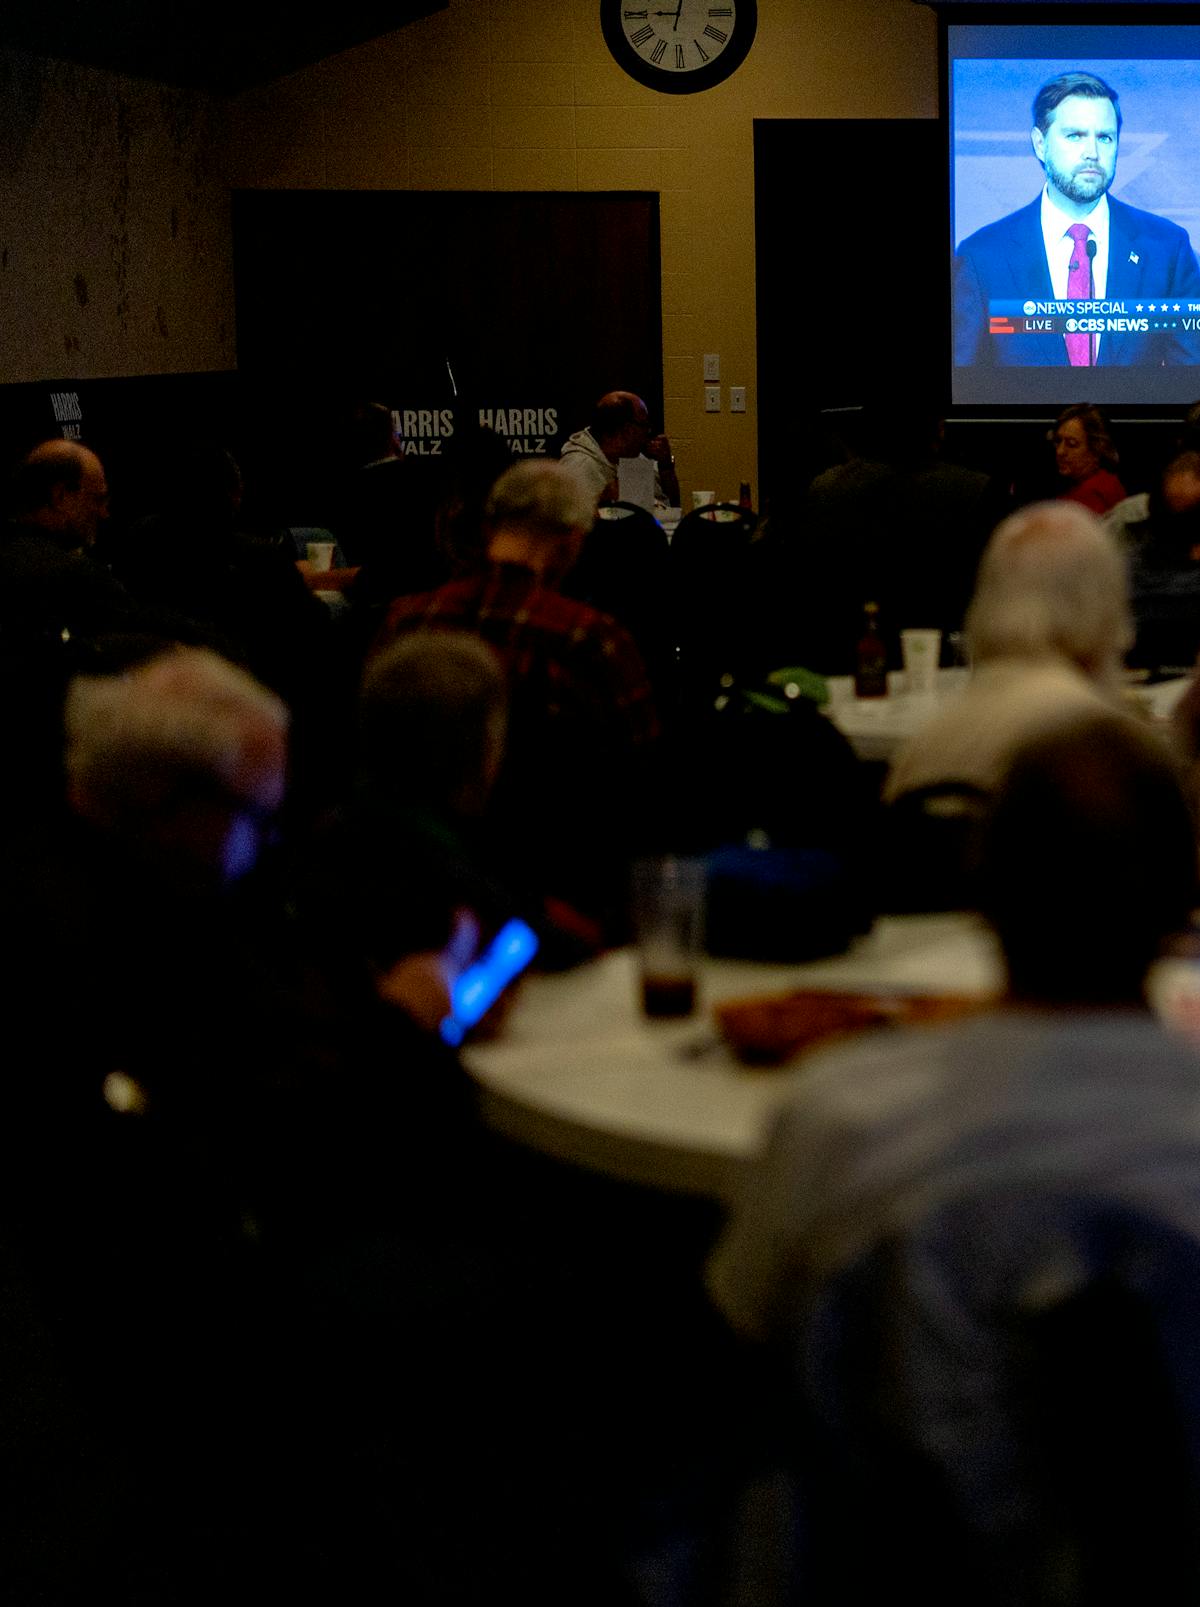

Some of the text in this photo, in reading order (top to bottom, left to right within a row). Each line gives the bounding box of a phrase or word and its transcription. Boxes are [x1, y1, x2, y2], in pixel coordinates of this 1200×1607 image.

[708, 8, 732, 17] III
[1037, 301, 1075, 314] NEWS
[1076, 301, 1128, 314] SPECIAL
[1025, 319, 1052, 331] LIVE
[1077, 318, 1105, 332] CBS
[1106, 318, 1149, 332] NEWS
[391, 409, 454, 437] ARRIS
[479, 408, 559, 435] HARRIS
[506, 439, 546, 453] ALZ
